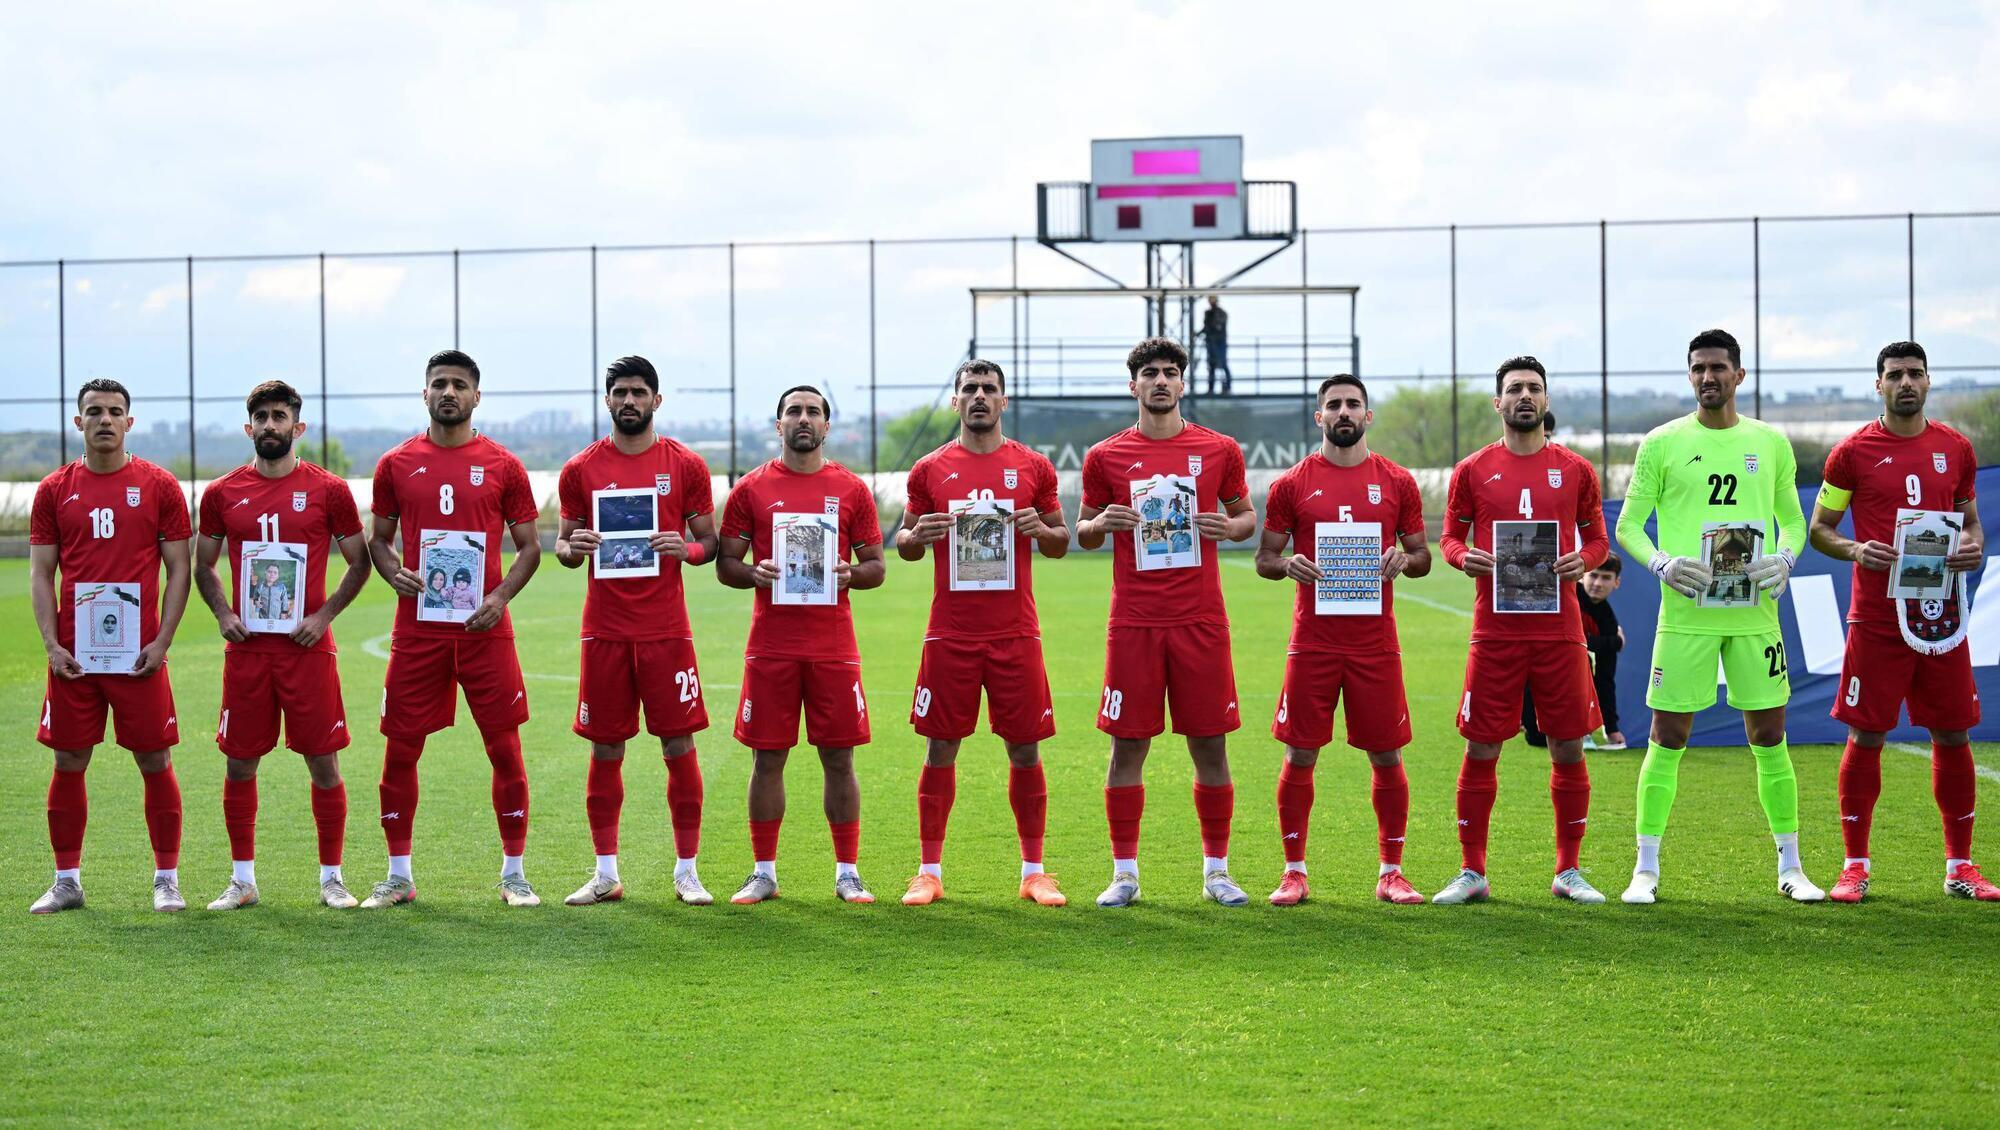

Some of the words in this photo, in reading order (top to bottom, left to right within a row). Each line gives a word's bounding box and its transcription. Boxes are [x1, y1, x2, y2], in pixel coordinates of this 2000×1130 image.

[439, 483, 454, 515] 8
[1518, 488, 1533, 519] 4
[1708, 474, 1738, 506] 22
[1905, 474, 1921, 506] 9
[88, 507, 115, 539] 18
[256, 513, 279, 543] 11
[1764, 641, 1787, 678] 22
[675, 666, 699, 703] 25
[1845, 676, 1861, 707] 9
[1101, 685, 1123, 720] 28
[1461, 690, 1472, 722] 4
